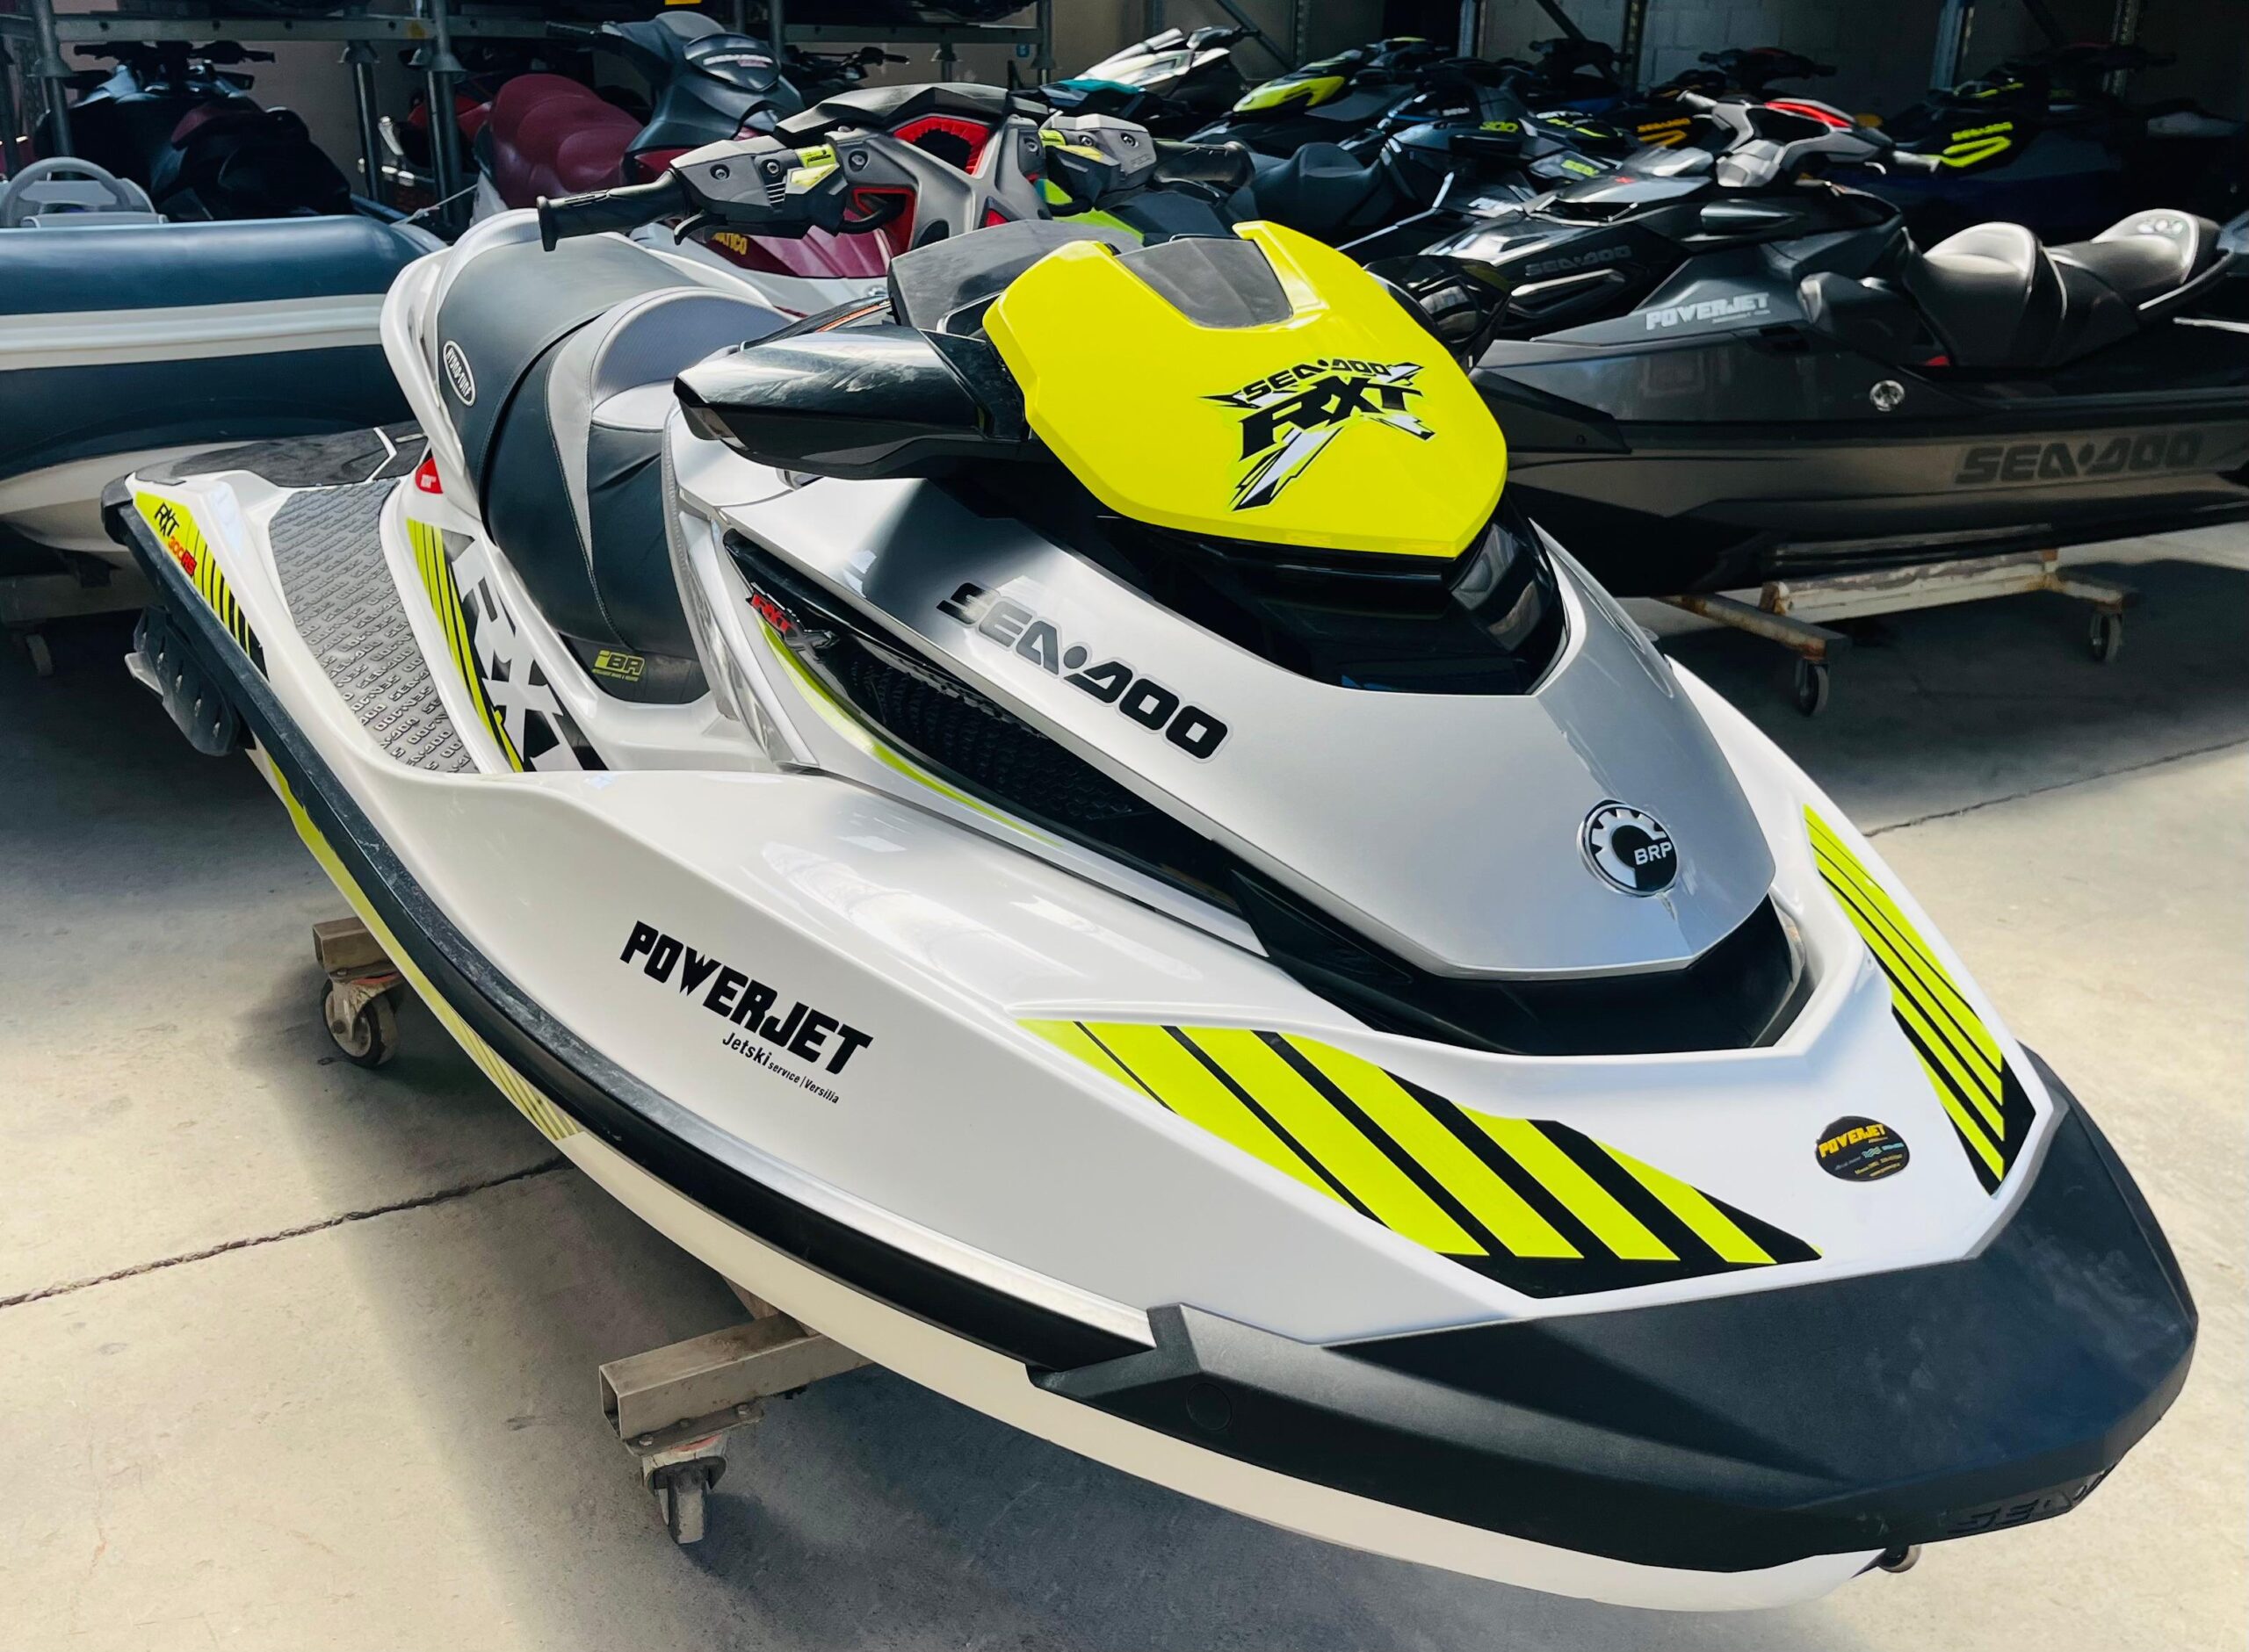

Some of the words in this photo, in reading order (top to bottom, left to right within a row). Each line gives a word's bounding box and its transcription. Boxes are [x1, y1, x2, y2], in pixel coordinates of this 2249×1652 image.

[1646, 292, 1769, 330] POWERJET
[1238, 375, 1423, 462] RXT
[1634, 841, 1673, 865] BRP
[619, 920, 873, 1075] POWERJET
[722, 1032, 772, 1066] Jetski
[768, 1061, 800, 1083] service
